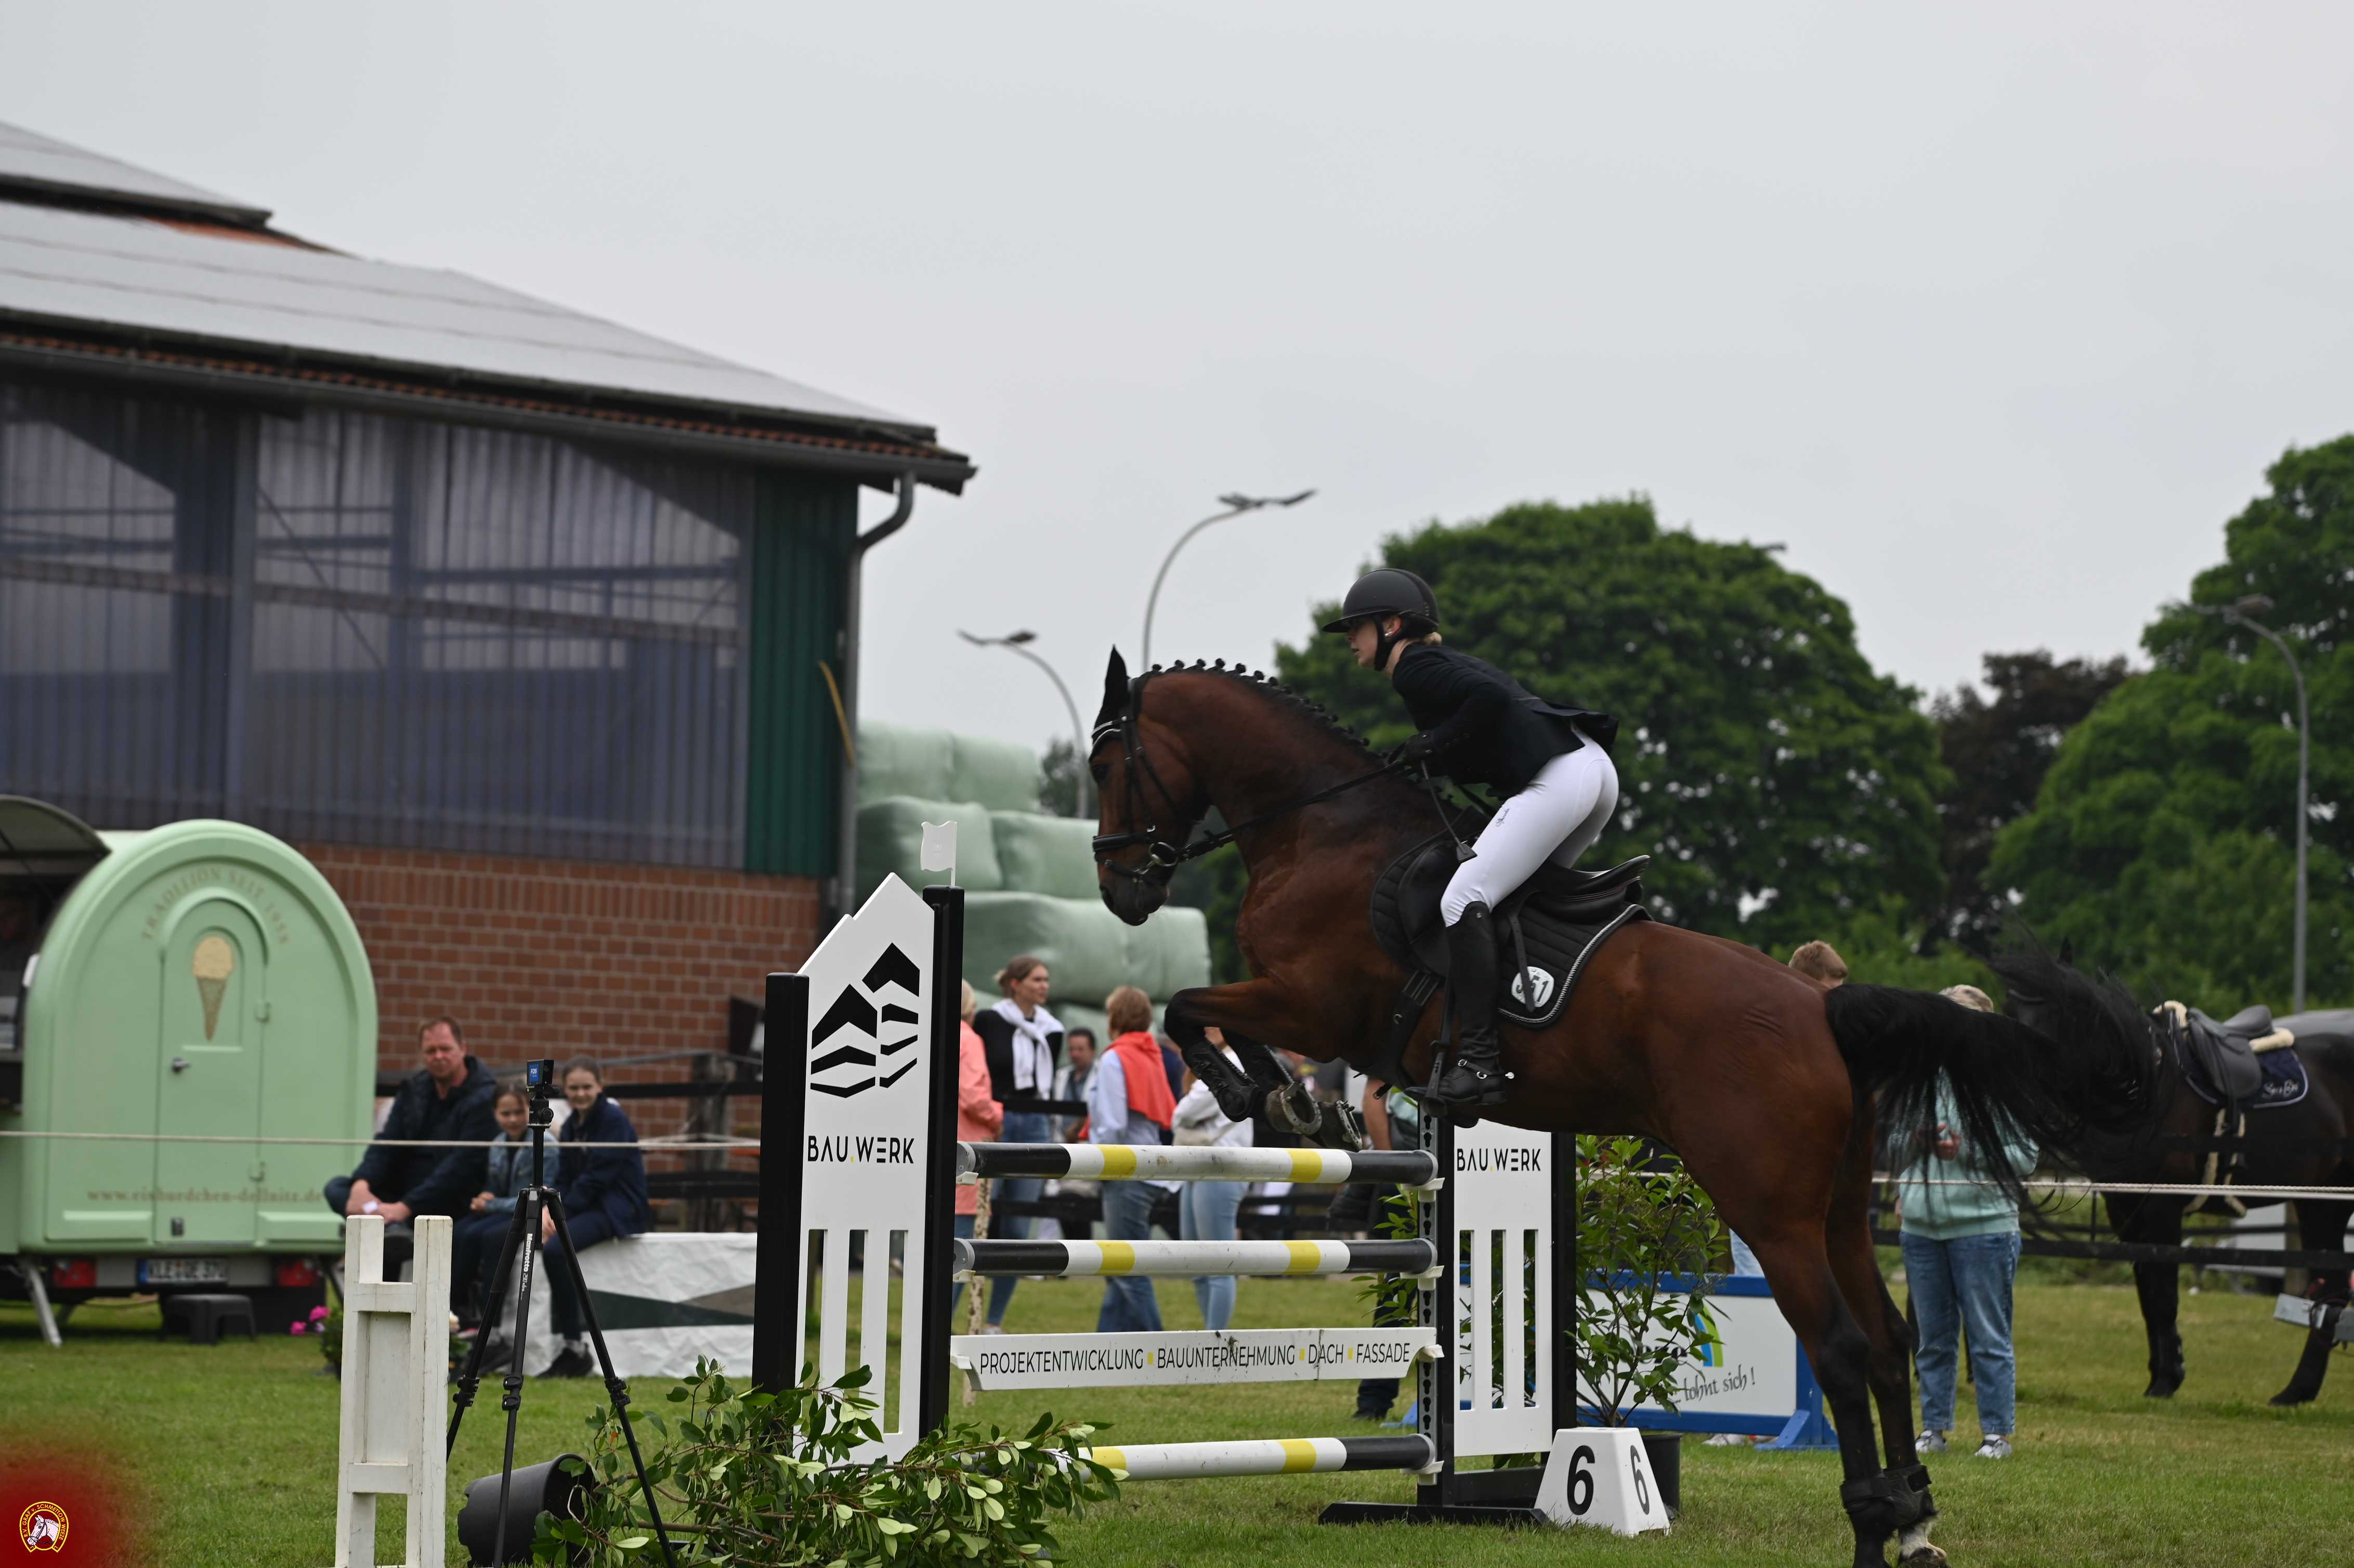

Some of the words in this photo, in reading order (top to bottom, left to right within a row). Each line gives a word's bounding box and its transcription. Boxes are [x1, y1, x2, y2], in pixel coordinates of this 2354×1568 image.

[524, 1233, 533, 1272] Manfrotto
[980, 1348, 1144, 1375] PROJEKTENTWICKLUNG
[1157, 1344, 1296, 1369] BAUUNTERNEHMUNG
[1308, 1343, 1344, 1364] DACH
[1356, 1342, 1410, 1364] FASSADE
[1684, 1374, 1720, 1402] lohnt
[1567, 1445, 1596, 1516] 6
[1630, 1445, 1650, 1515] 6
